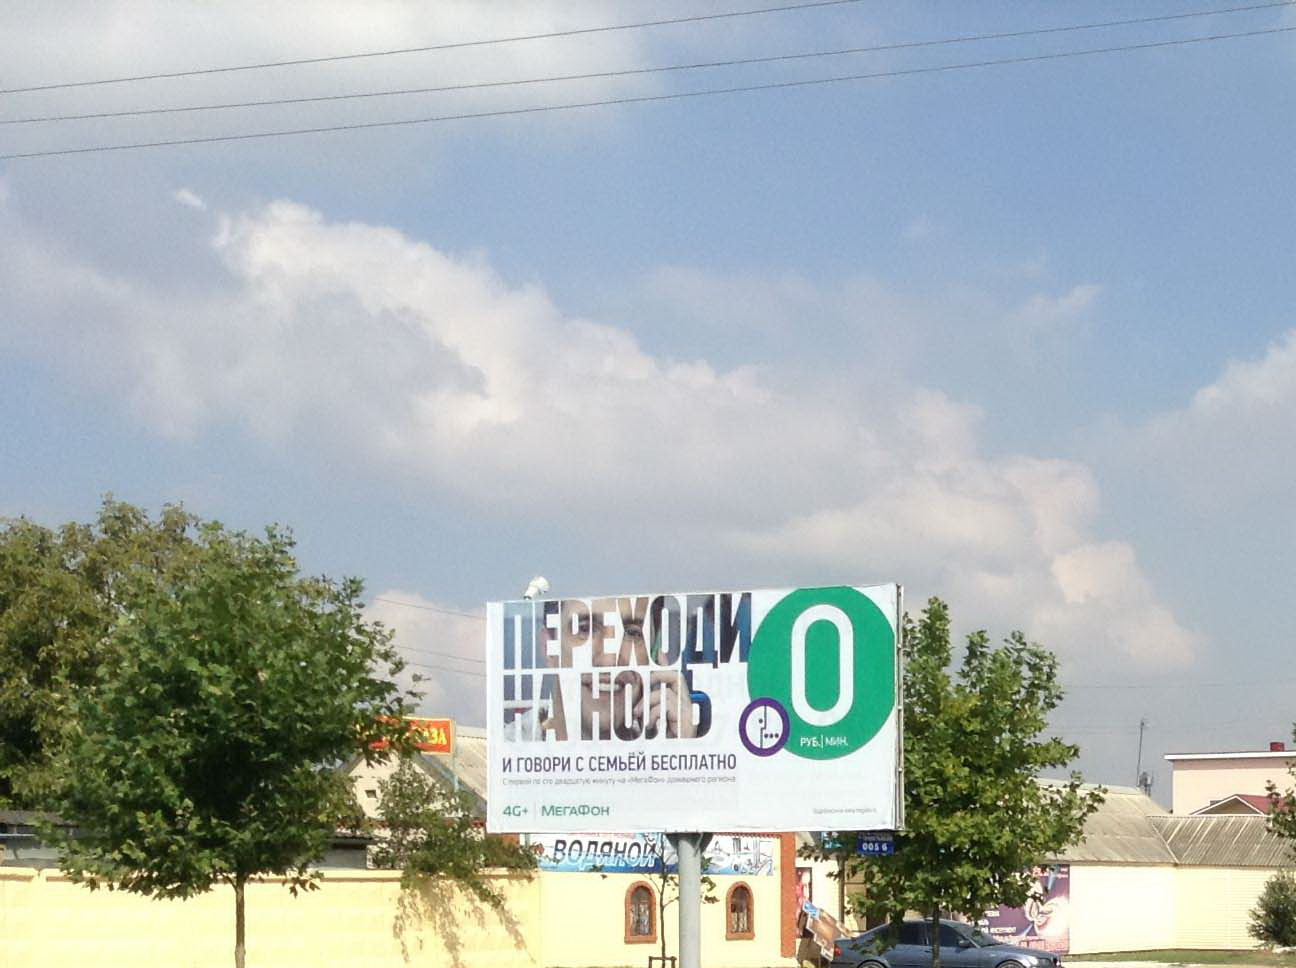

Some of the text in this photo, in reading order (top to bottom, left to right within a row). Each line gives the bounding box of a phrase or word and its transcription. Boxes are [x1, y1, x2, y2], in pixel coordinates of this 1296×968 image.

[503, 592, 752, 669] ПЕРЕХОДИ
[503, 669, 712, 742] НА НОЛЬ
[502, 752, 737, 773] И ГОВОРИ С СЕМЬЁЙ БЕСПЛАТНО
[553, 833, 658, 864] ВОДЯНОЙ
